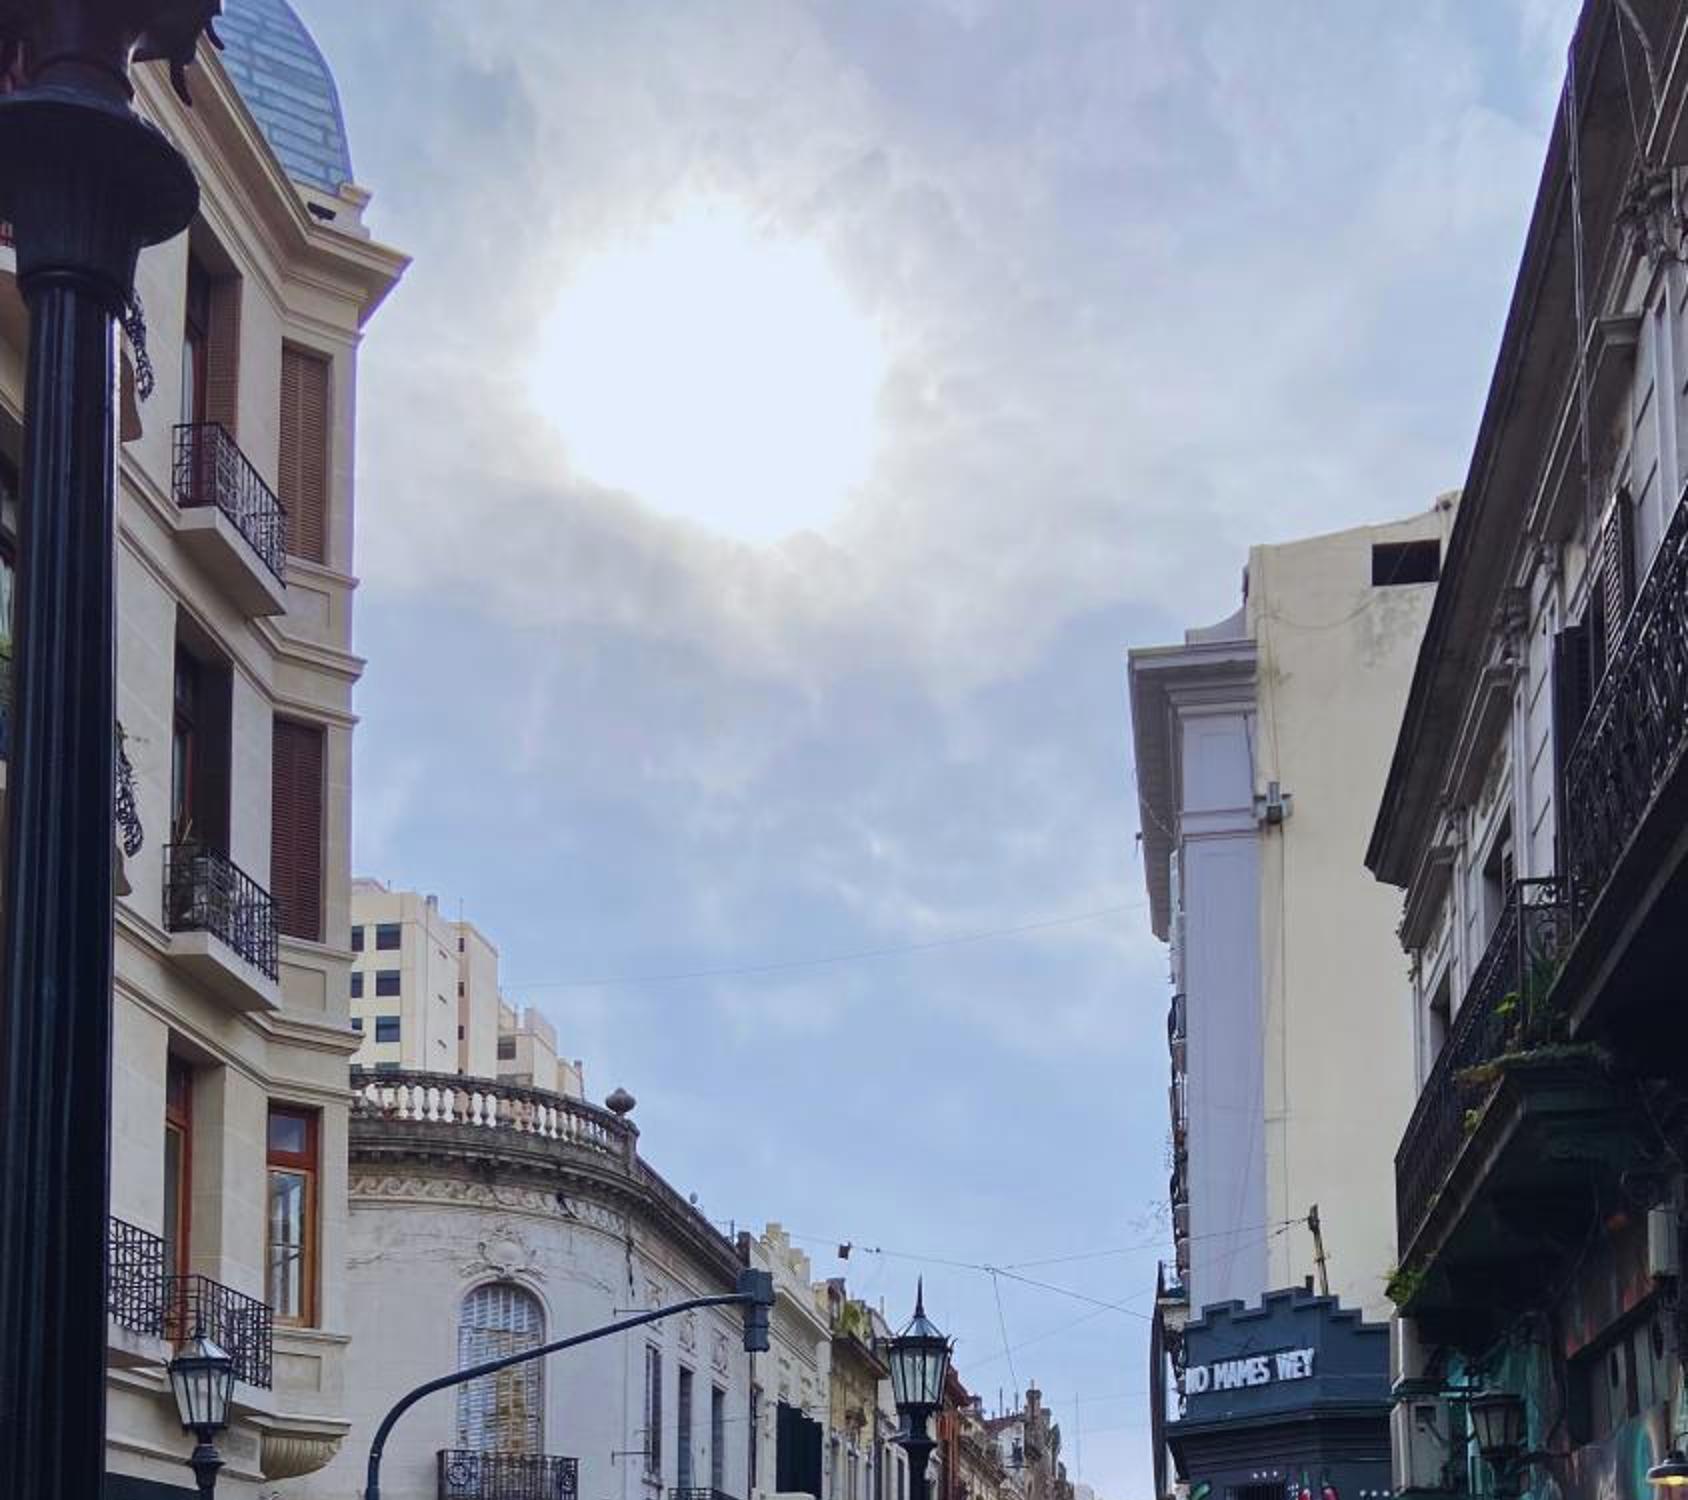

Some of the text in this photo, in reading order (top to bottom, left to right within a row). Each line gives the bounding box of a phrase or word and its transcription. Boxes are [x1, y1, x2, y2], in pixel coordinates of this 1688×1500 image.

[1185, 1347, 1314, 1395] NO MAMES WEY
